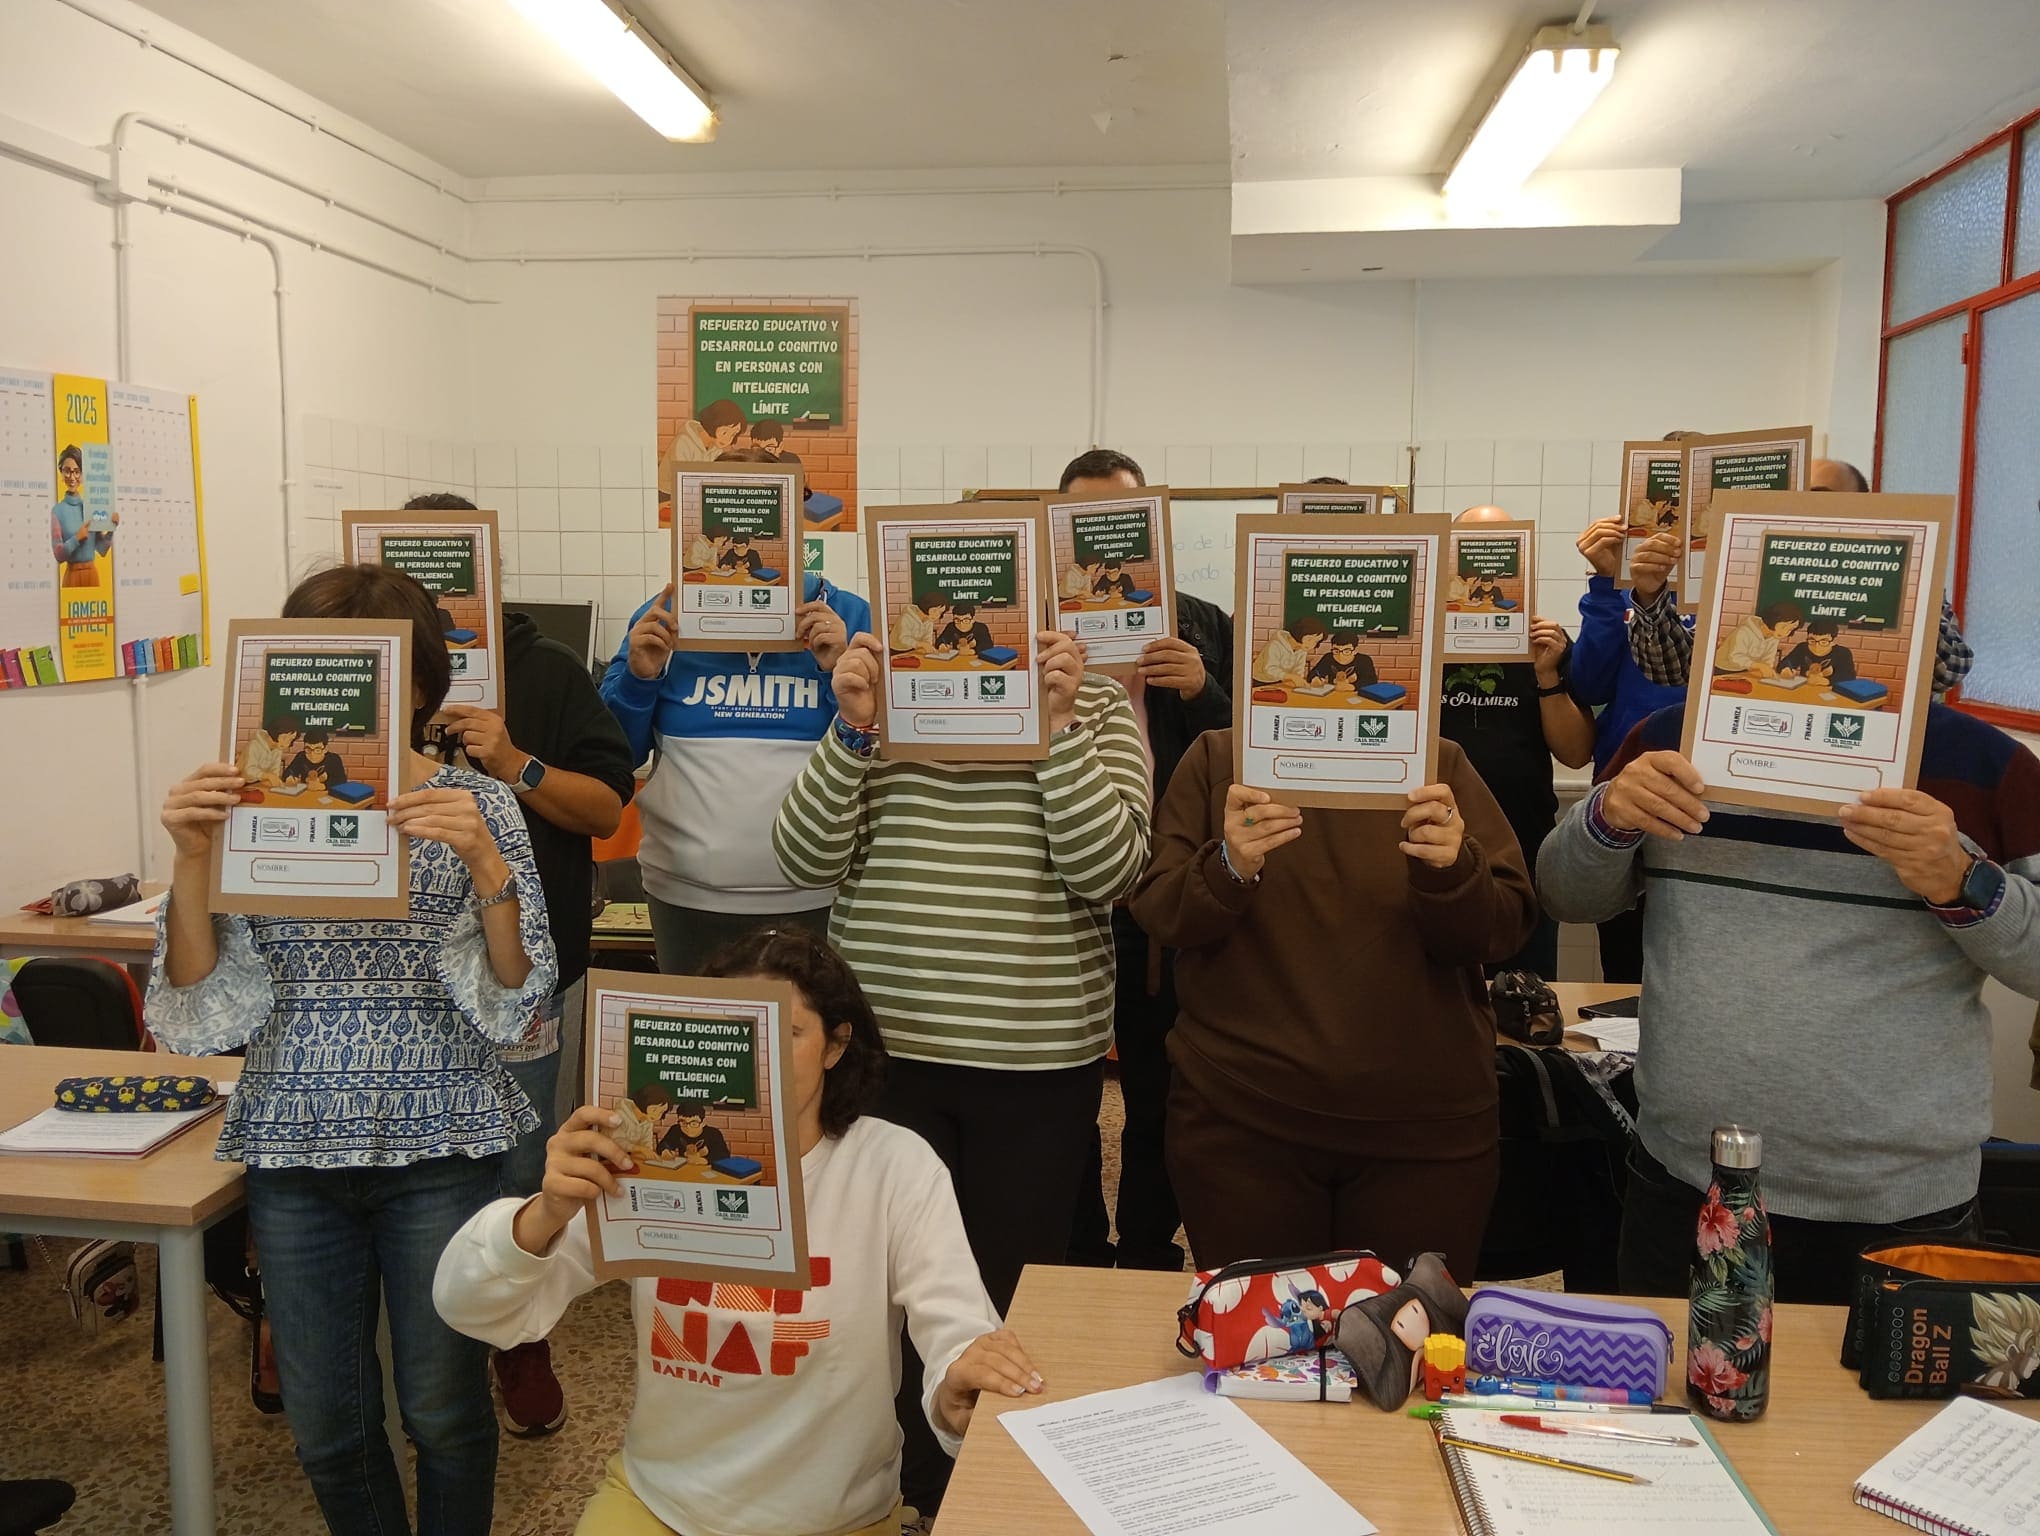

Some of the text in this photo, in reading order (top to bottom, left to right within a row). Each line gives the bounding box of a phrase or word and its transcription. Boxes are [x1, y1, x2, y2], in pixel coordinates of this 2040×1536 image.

[700, 320, 839, 331] REFUERZO EDUCATIVO Y
[701, 341, 837, 352] DESARROLLO COGNITIVO
[716, 362, 822, 373] EN PERSONAS CON
[733, 382, 809, 393] INTELIGENCIA
[66, 394, 96, 425] 2025
[753, 400, 789, 414] LÍMITE
[1715, 457, 1745, 465] REFUERZO
[1747, 455, 1780, 463] EDUCATIVO
[1716, 466, 1753, 474] DESARROLLO
[733, 525, 752, 533] LÍMITE
[1077, 525, 1114, 533] DESARROLLO
[1095, 533, 1125, 541] PERSONAS
[915, 540, 956, 549] REFUERZO
[959, 540, 1003, 548] EDUCATIVO
[1094, 542, 1133, 550] INTELIGENCIA
[1771, 540, 1902, 555] REFUERZO EDUCATIVO Y
[916, 553, 1011, 562] DESARROLLO COGNITIVO
[1291, 559, 1408, 568] REFUERZO EDUCATIVO Y
[1769, 556, 1900, 571] DESARROLLO COGNITIVO
[940, 566, 982, 574] PERSONAS
[939, 579, 992, 587] INTELIGENCIA
[1292, 574, 1407, 583] DESARROLLO COGNITIVO
[1781, 573, 1883, 587] EN PERSONAS CON
[953, 591, 979, 600] LÍMITE
[1303, 589, 1394, 598] EN PERSONAS CON
[1794, 589, 1868, 602] INTELIGENCIA
[1317, 604, 1382, 613] INTELIGENCIA
[1811, 604, 1847, 617] LÍMITE
[1333, 617, 1364, 627] LÍMITE
[271, 659, 312, 667] REFUERZO
[315, 659, 363, 667] EDUCATIVO
[271, 673, 372, 682] DESARROLLO COGNITIVO
[294, 688, 338, 696] PERSONAS
[342, 689, 360, 697] CON
[682, 675, 818, 708] JSMITH
[291, 703, 349, 711] INTELIGENCIA
[306, 715, 333, 725] LÍMITE
[1805, 714, 1814, 740] FINANCIA
[634, 1019, 749, 1035] REFUERZO EDUCATIVO Y
[634, 1036, 749, 1052] DESARROLLO COGNITIVO
[646, 1054, 736, 1068] EN PERSONAS CON
[660, 1071, 726, 1083] INTELIGENCIA
[678, 1088, 709, 1098] LÍMITE
[1904, 1308, 1930, 1385] Dragon
[1929, 1325, 1952, 1384] Ball Z
